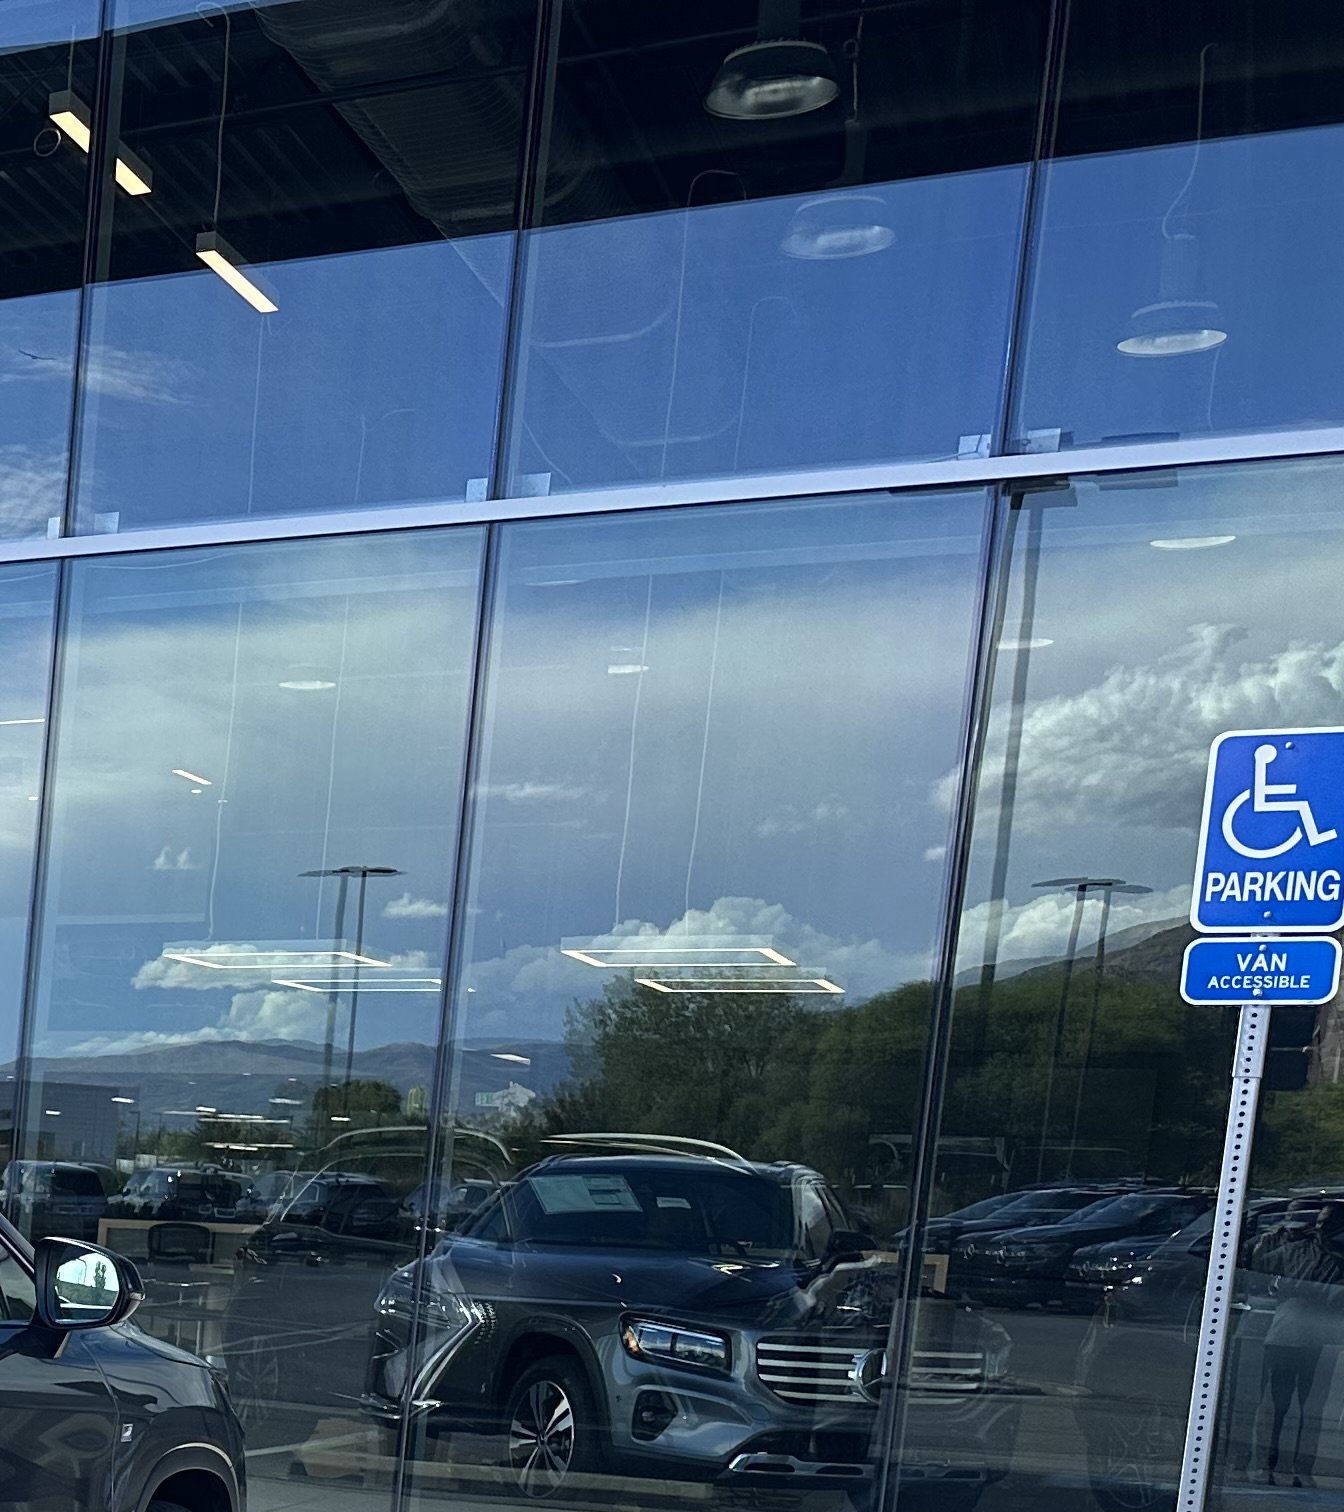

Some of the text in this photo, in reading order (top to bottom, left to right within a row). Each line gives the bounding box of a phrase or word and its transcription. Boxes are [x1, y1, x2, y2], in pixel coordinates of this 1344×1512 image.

[1205, 869, 1341, 902] PARKING
[1236, 952, 1288, 972] VAN
[1207, 975, 1311, 990] ACCESSIBLE
